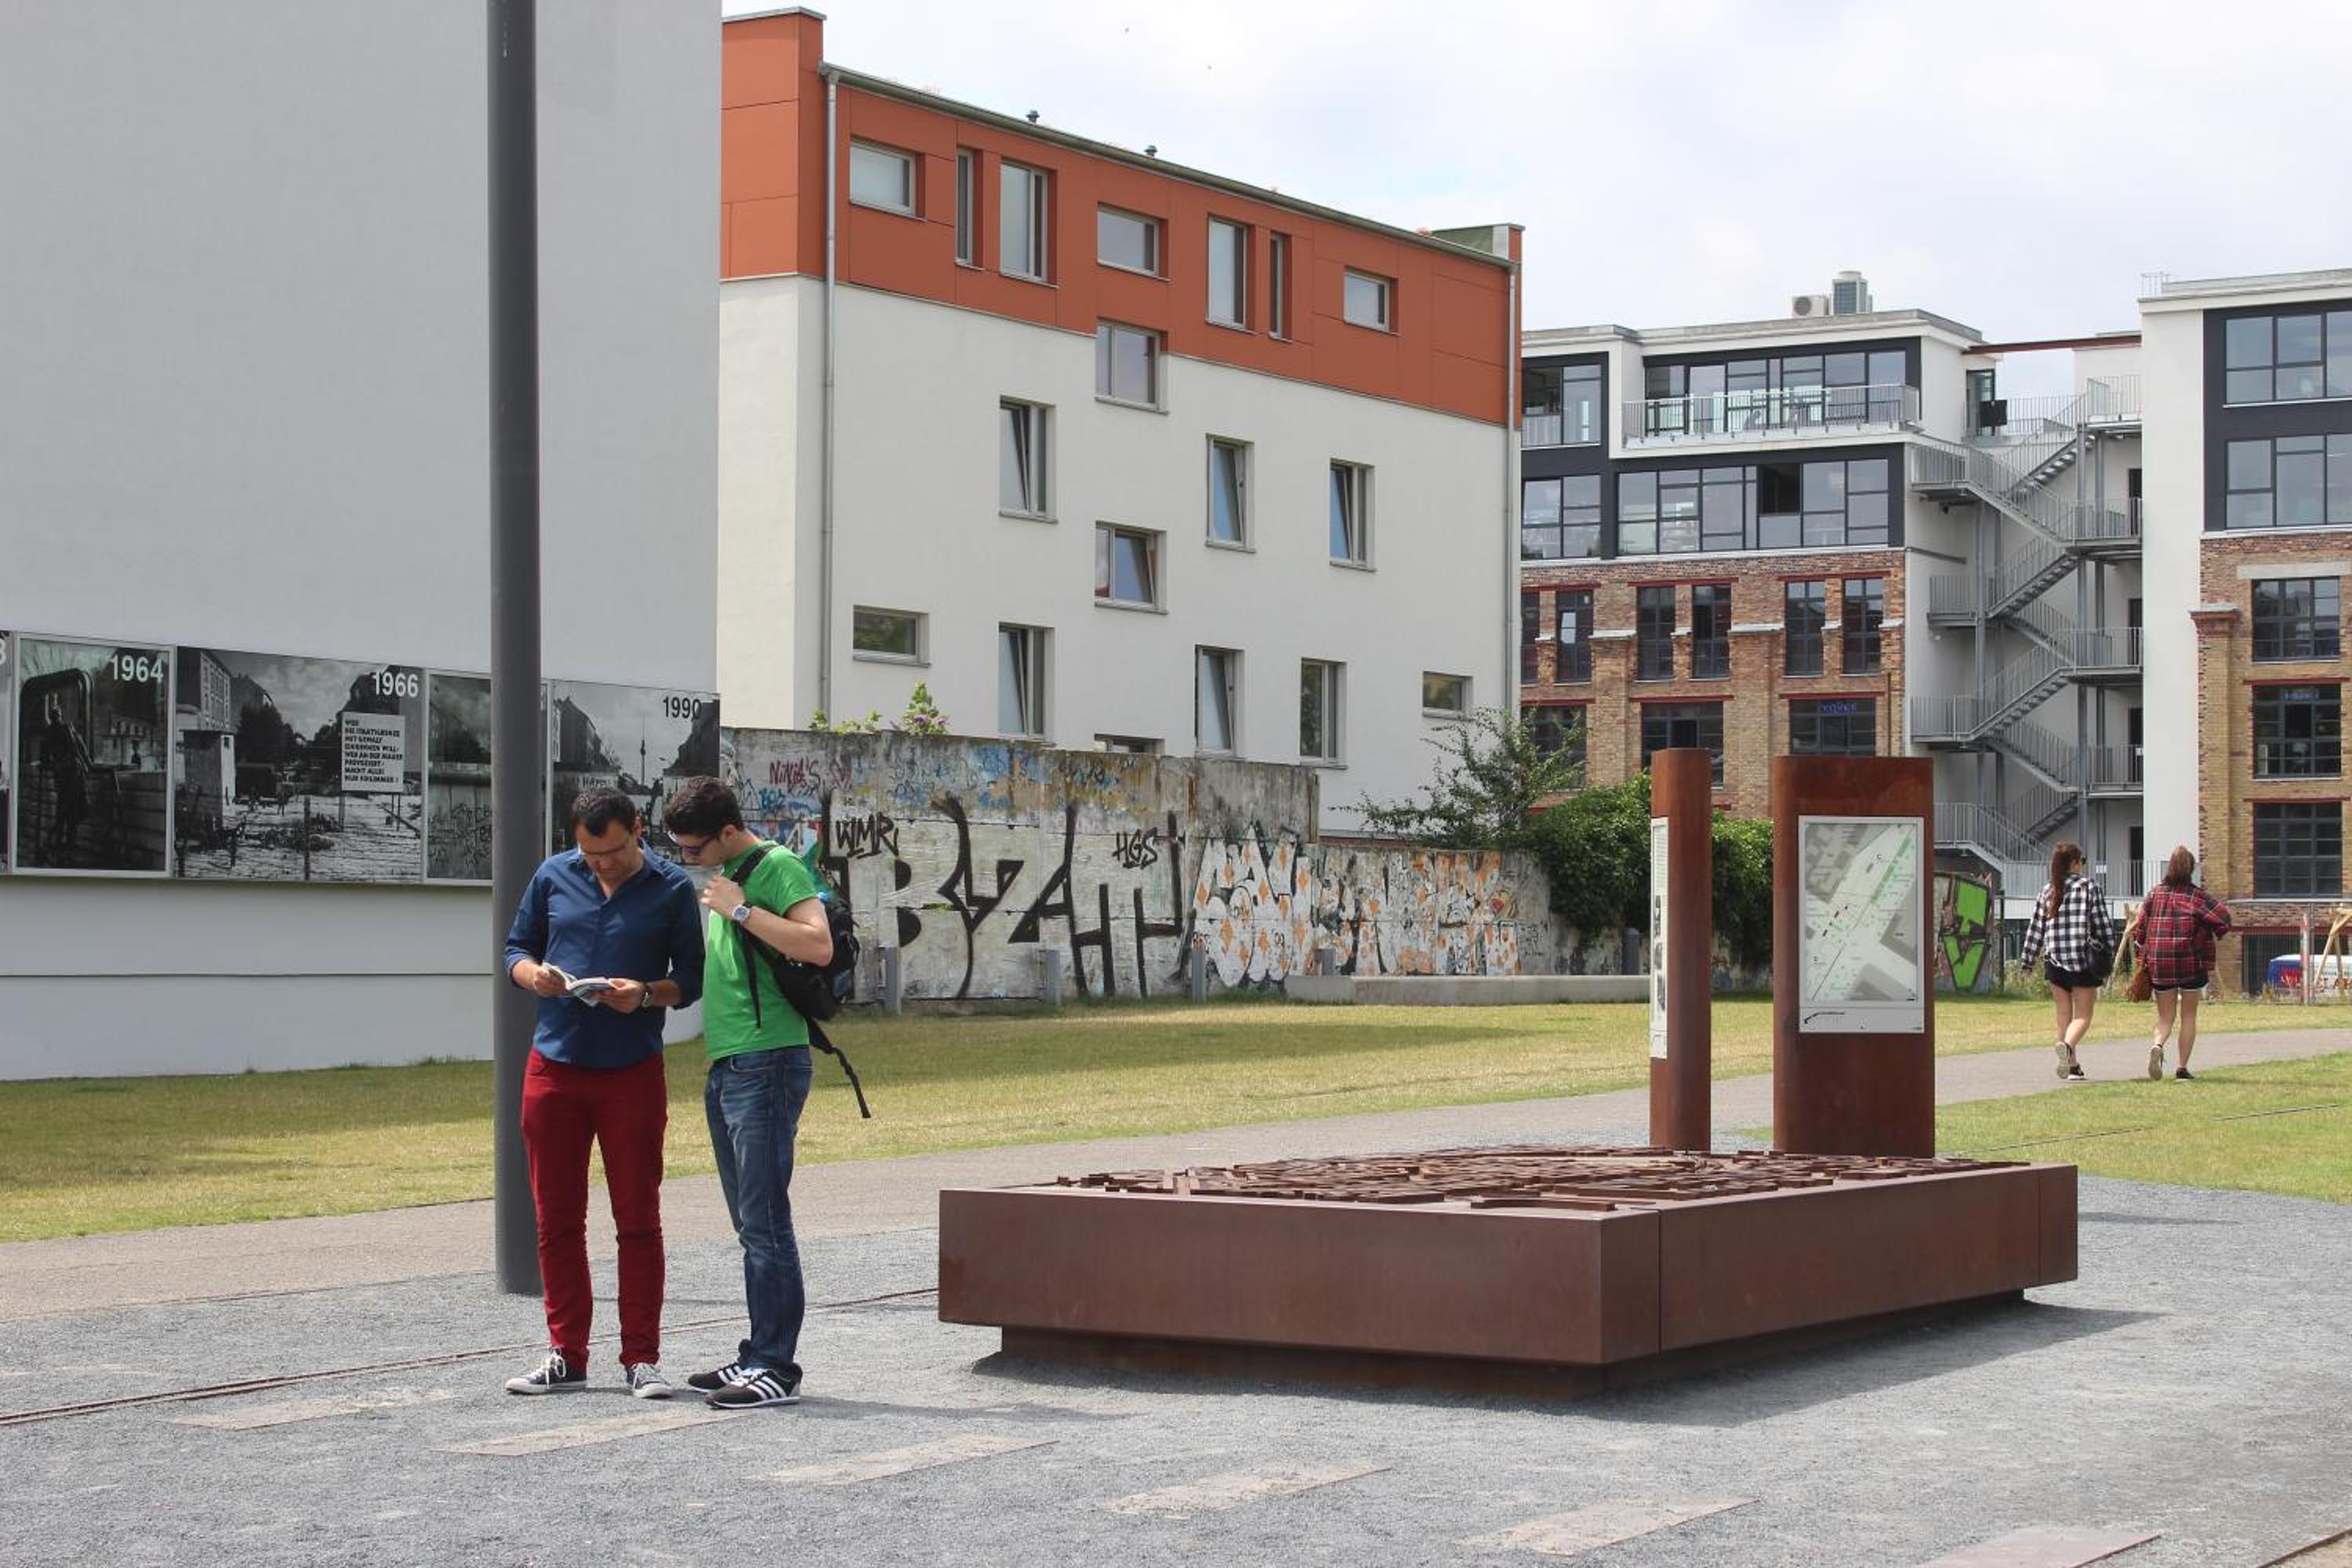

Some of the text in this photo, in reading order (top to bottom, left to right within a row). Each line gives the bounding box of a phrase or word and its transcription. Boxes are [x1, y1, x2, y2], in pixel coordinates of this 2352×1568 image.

[109, 654, 164, 684] 1964
[372, 671, 419, 698] 1966
[662, 696, 702, 719] 1990
